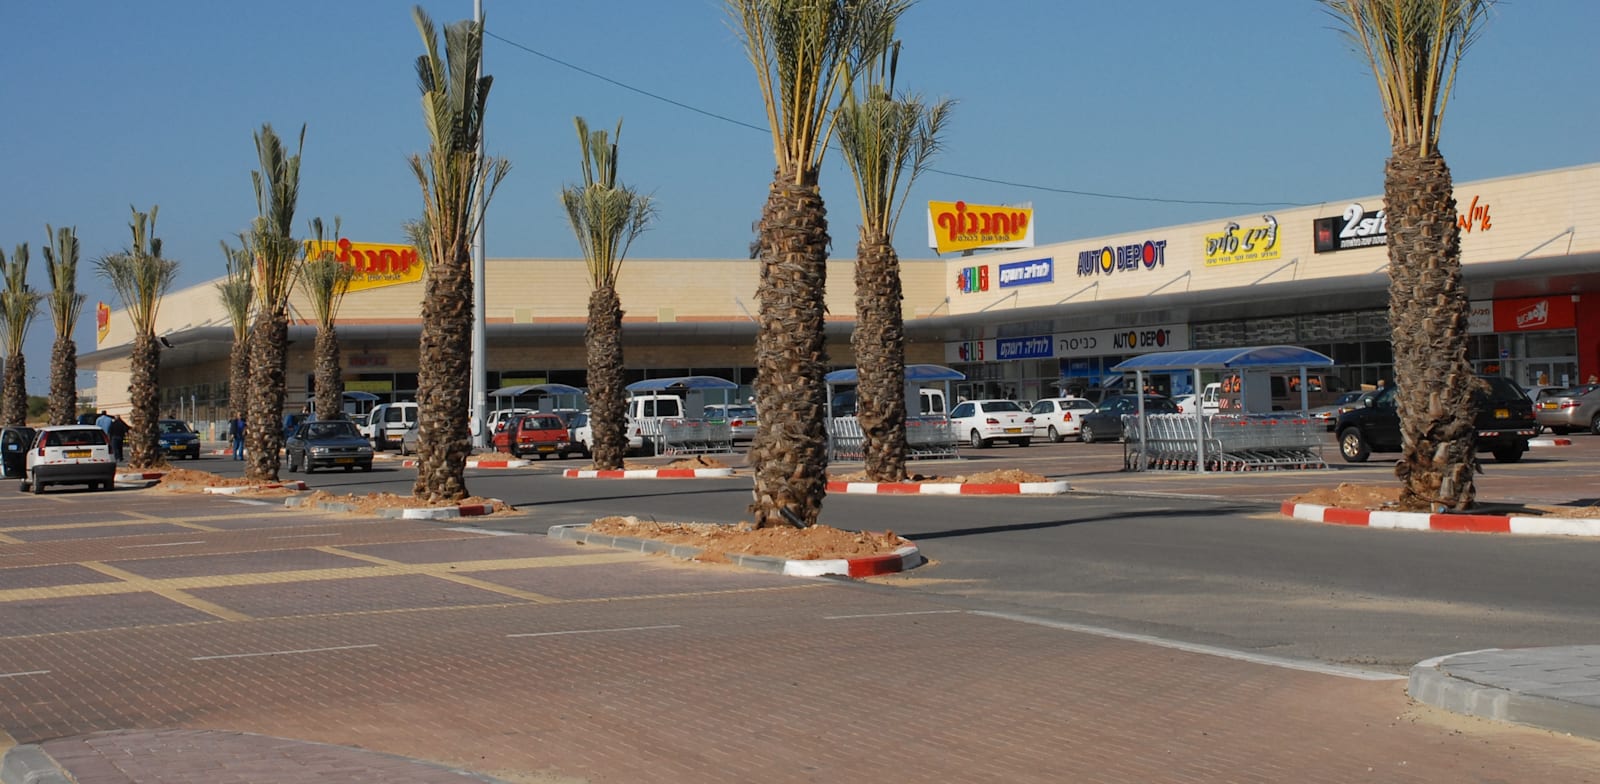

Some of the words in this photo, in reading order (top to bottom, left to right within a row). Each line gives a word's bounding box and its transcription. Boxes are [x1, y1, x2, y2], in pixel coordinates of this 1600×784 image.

[1077, 246, 1115, 277] AUTO
[1117, 240, 1166, 271] DEPOT
[1060, 337, 1097, 351] כניסה
[1113, 331, 1137, 349] AUTO
[1140, 329, 1171, 348] DEPOT
